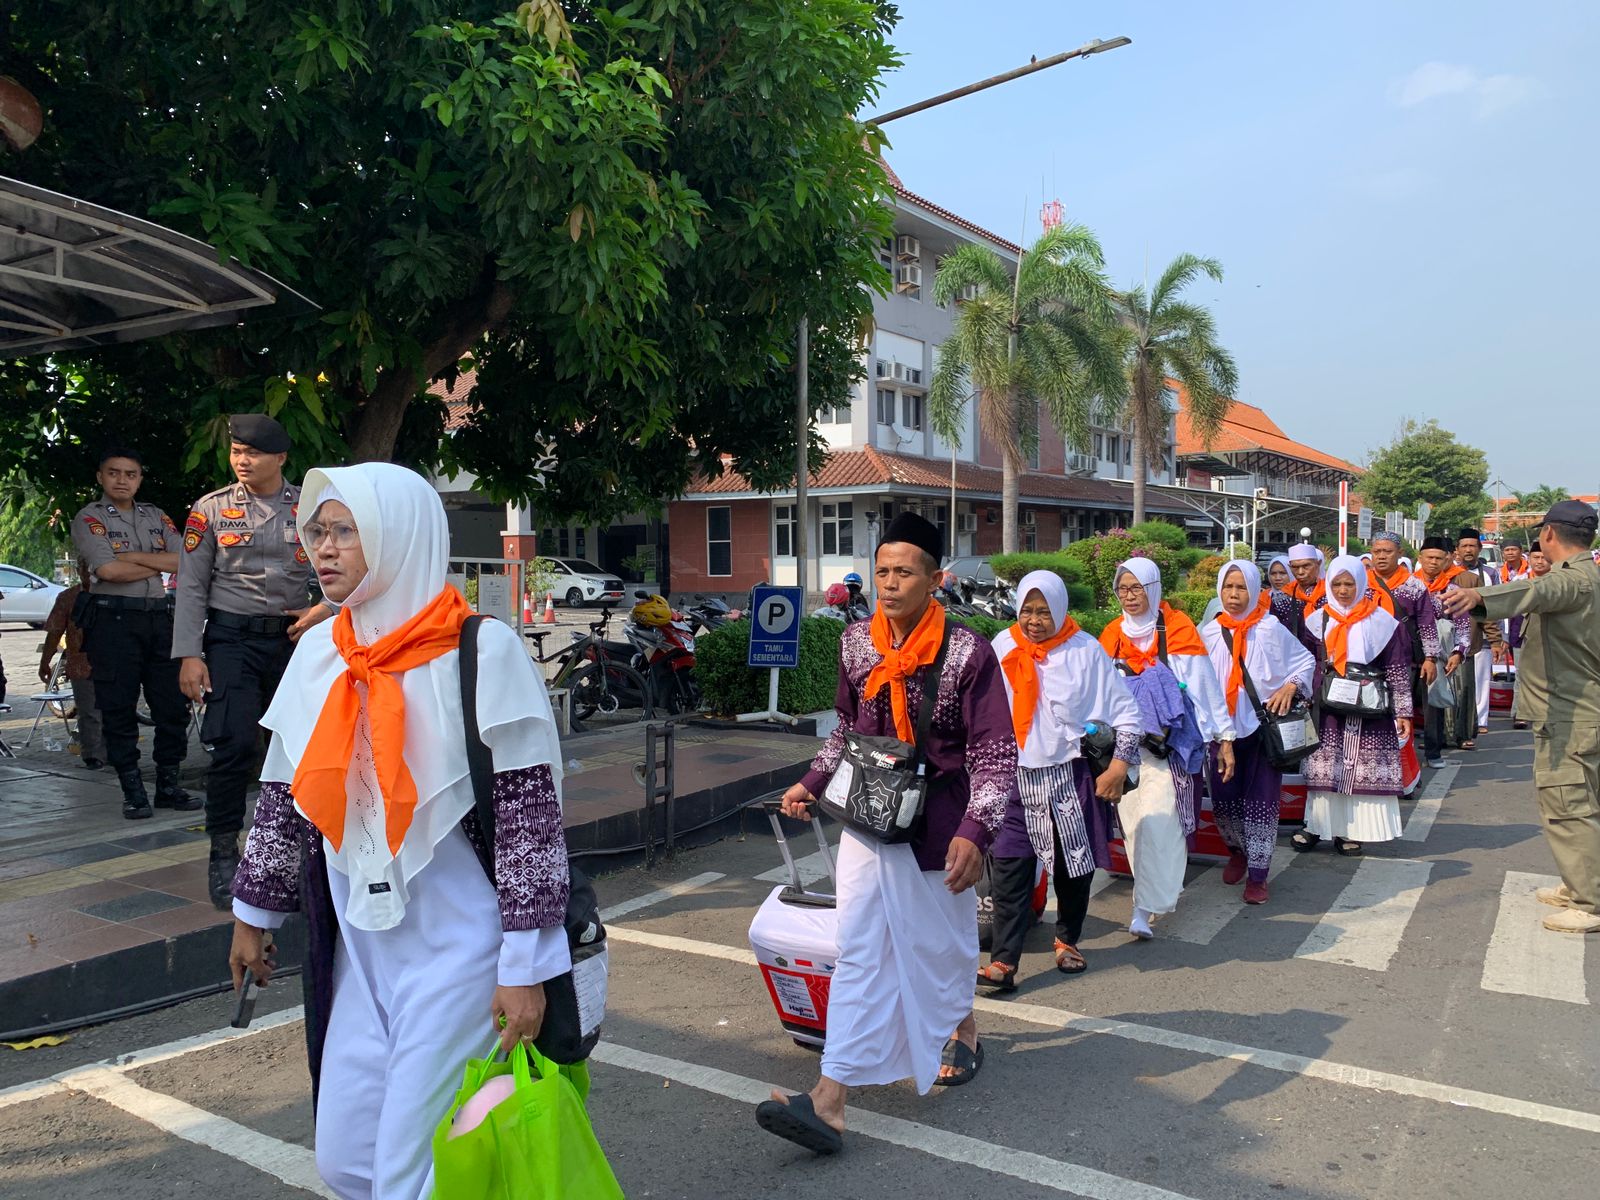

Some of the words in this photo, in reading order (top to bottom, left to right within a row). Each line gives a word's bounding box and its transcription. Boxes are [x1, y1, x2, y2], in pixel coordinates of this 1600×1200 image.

[768, 603, 786, 626] P
[764, 644, 784, 652] TAMU
[752, 654, 794, 662] SEMENTARA
